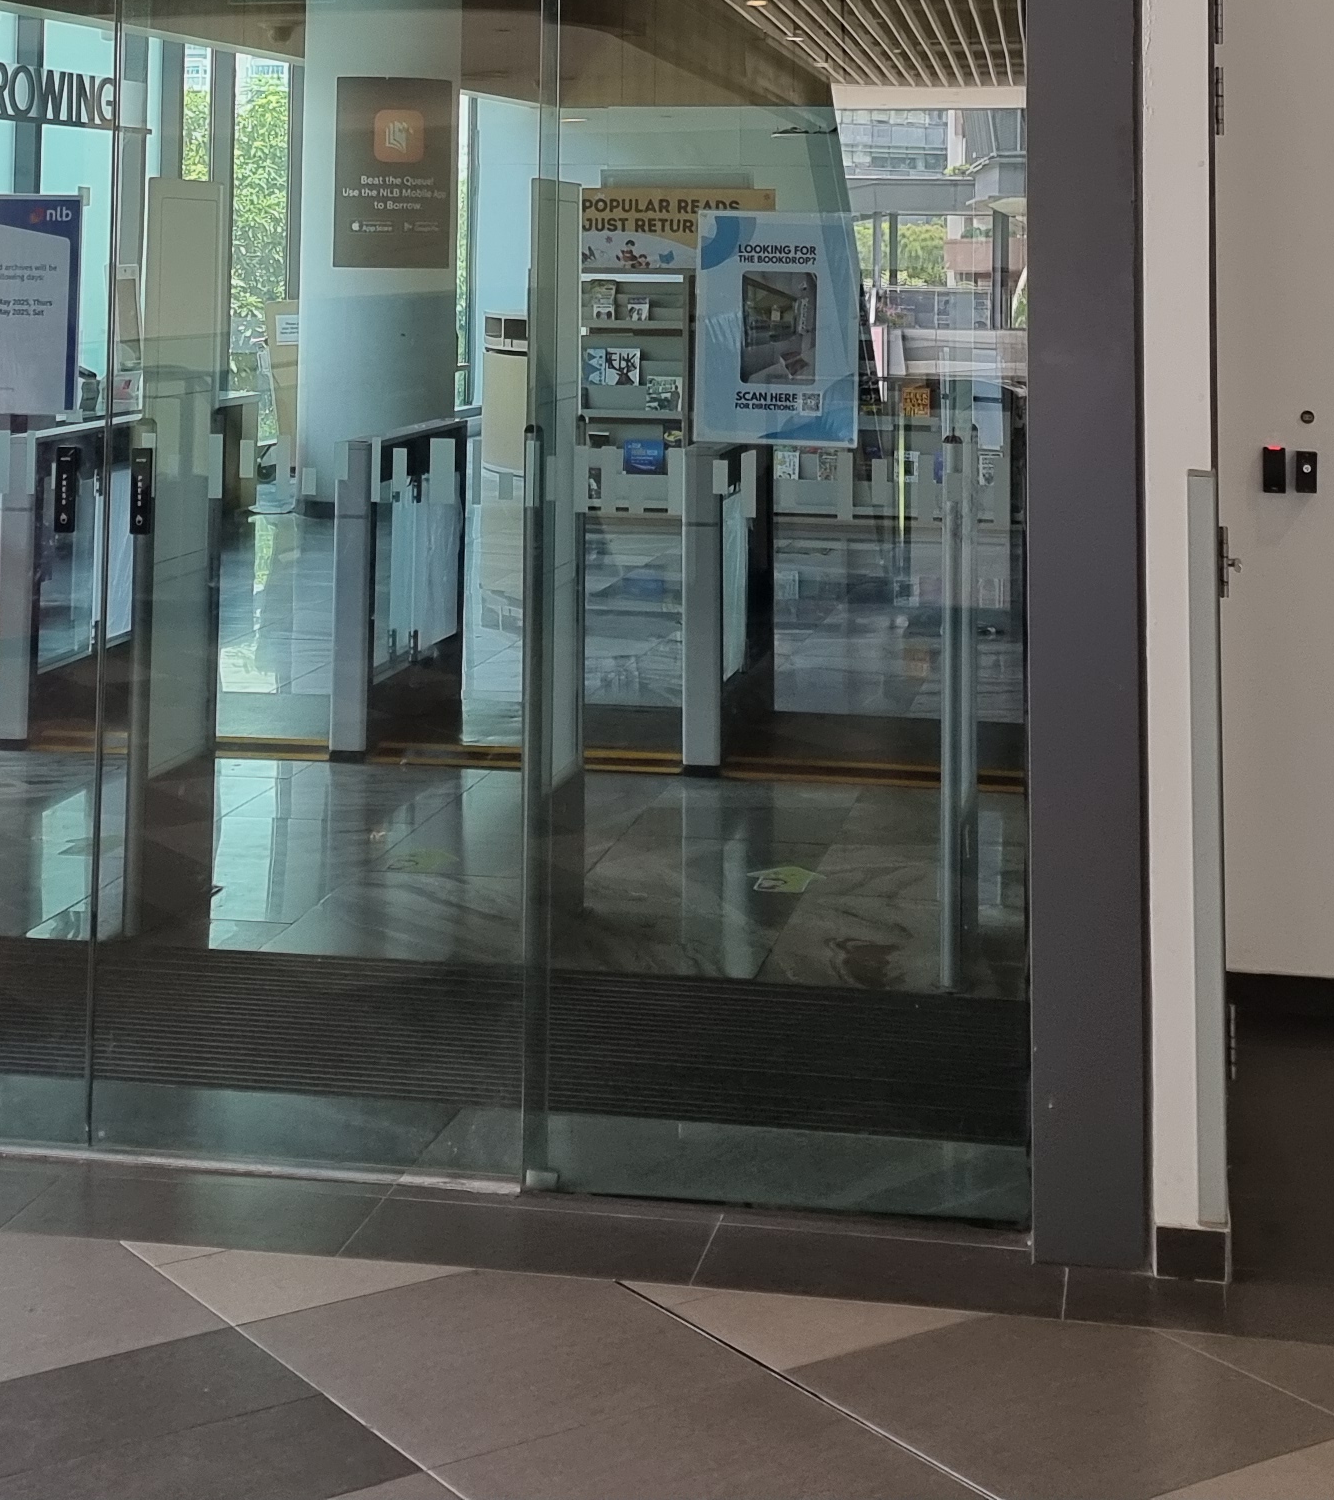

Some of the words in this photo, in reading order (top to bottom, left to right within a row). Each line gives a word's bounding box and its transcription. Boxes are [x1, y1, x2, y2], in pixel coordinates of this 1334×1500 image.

[361, 175, 383, 184] Beat
[385, 176, 402, 185] the
[342, 188, 359, 197] Use
[361, 188, 378, 197] the
[379, 188, 400, 197] NLB
[402, 189, 432, 198] Mobile
[374, 201, 384, 210] to
[582, 198, 671, 214] POPULAR
[677, 199, 740, 214] READS
[46, 206, 72, 221] nlb
[582, 218, 629, 233] JUST
[634, 218, 694, 234] RETUR
[738, 244, 791, 255] LOOKING
[794, 245, 816, 256] FOR
[739, 255, 756, 264] THE
[757, 255, 816, 265] BOOKDROP?
[735, 391, 767, 402] SCAN
[770, 392, 798, 403] HERE
